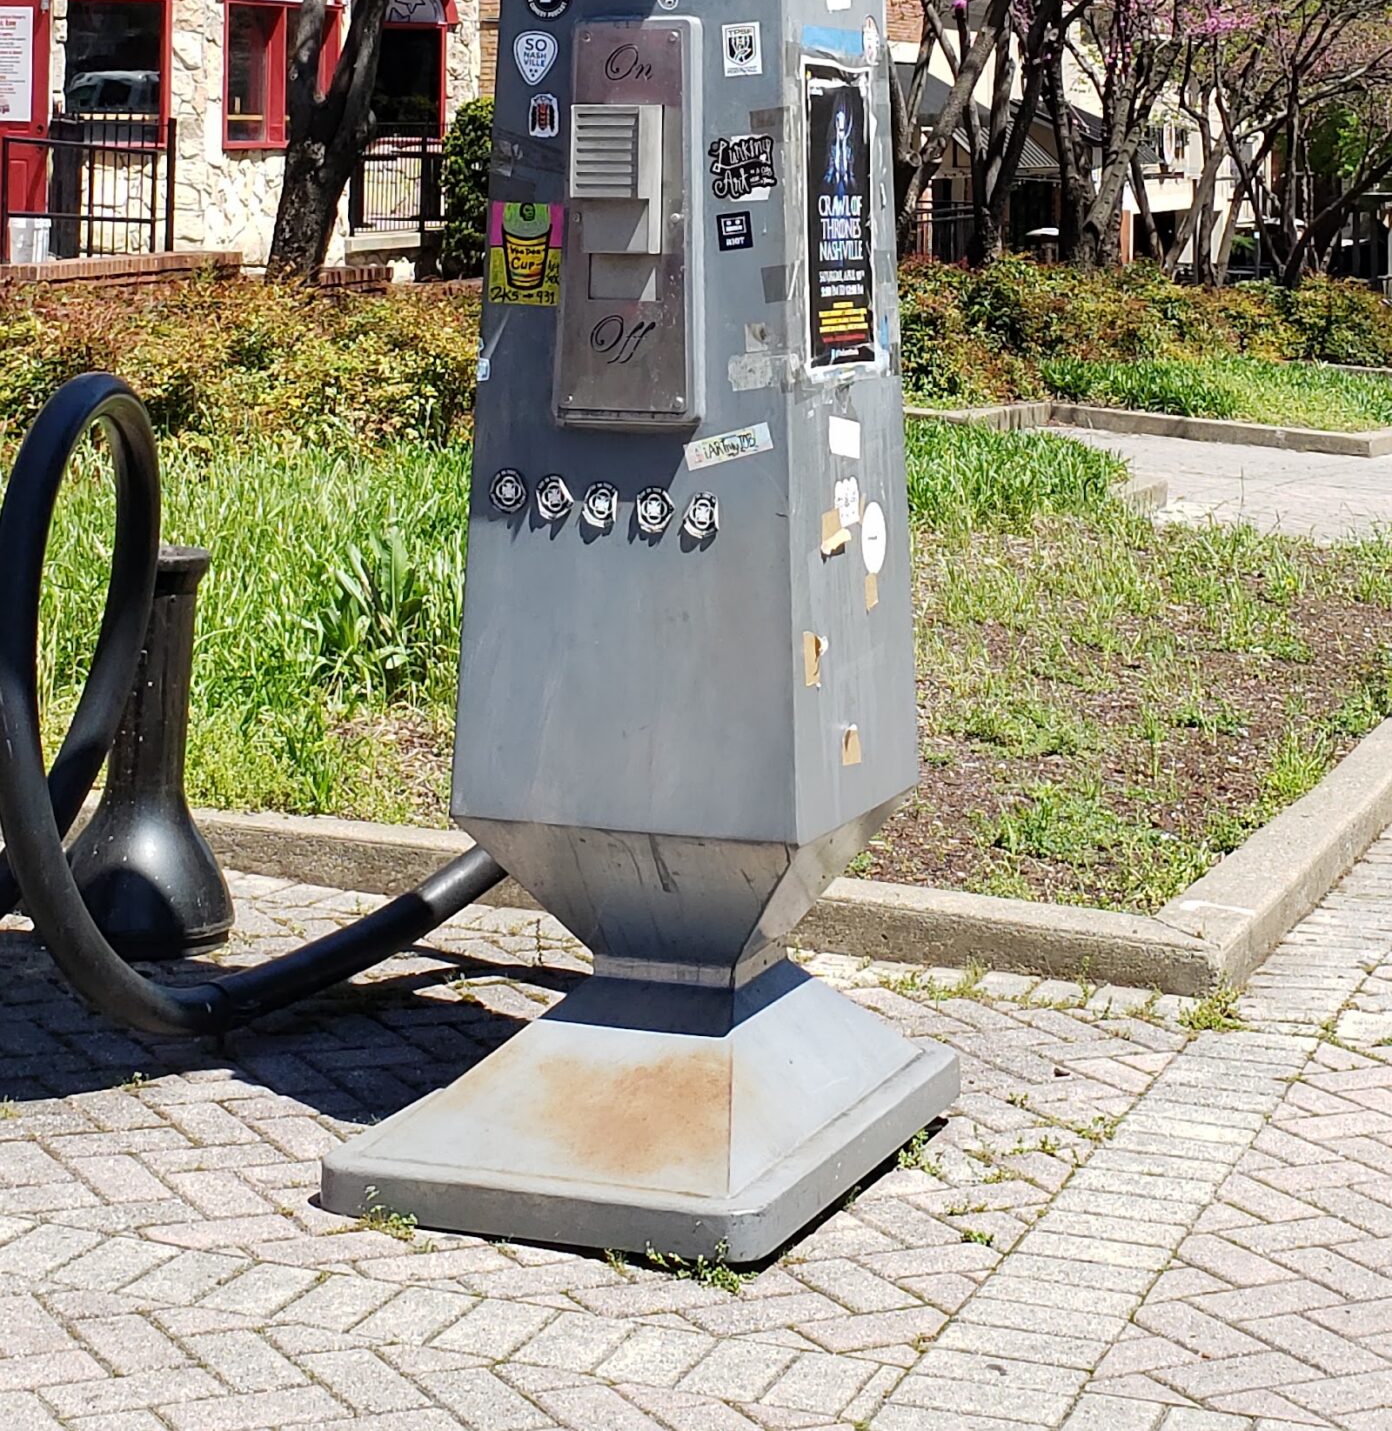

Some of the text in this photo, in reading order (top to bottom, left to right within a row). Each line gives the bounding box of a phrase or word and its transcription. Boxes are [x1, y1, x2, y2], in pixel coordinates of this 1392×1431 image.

[548, 2, 567, 17] PODCAST
[523, 51, 547, 59] NASH
[524, 38, 547, 52] SO
[523, 59, 545, 68] VILLE
[605, 43, 653, 81] On
[711, 139, 771, 172] Lurking
[714, 168, 750, 197] Art
[818, 195, 863, 217] CRAWL OF
[820, 217, 861, 240] THRONES
[726, 236, 745, 246] RIOT
[819, 240, 864, 262] NASHVILLE
[590, 314, 656, 364] Off
